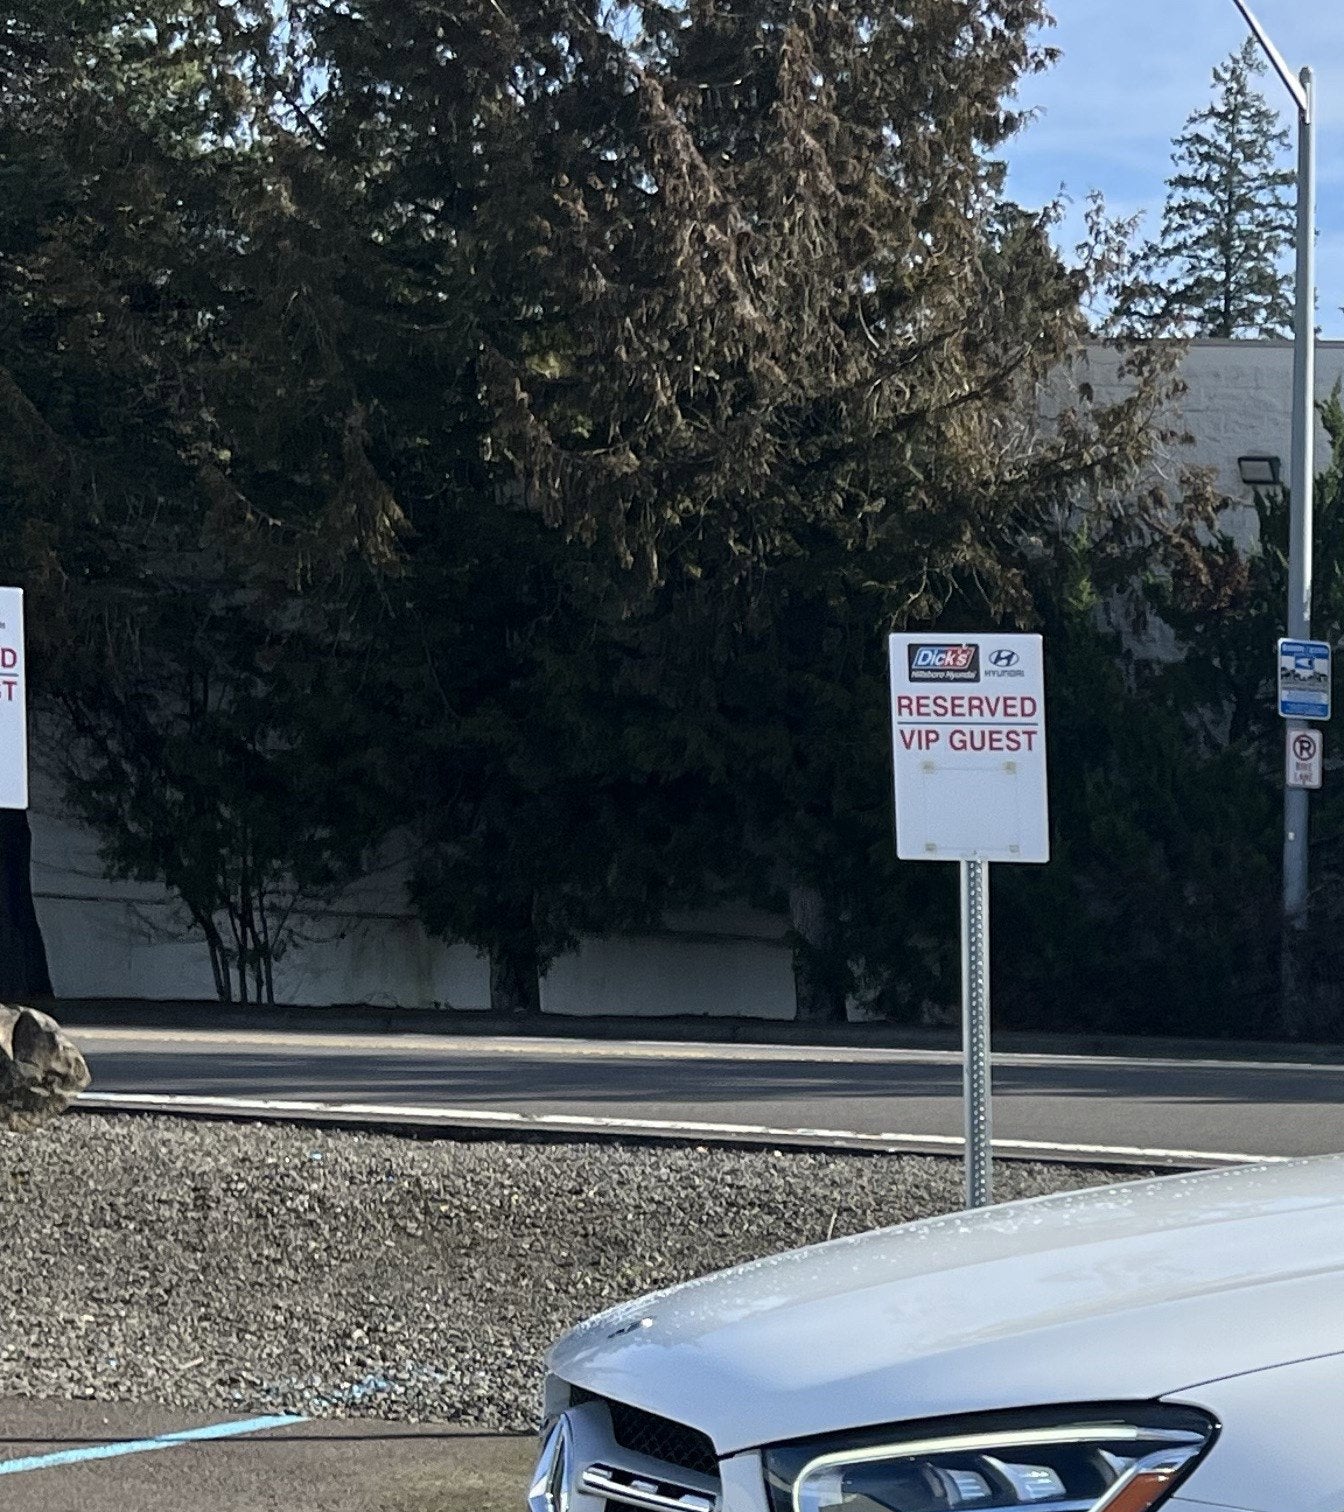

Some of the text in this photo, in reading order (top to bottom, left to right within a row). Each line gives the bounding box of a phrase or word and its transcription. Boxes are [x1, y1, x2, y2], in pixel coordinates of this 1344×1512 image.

[984, 669, 1025, 678] HYUNDAI
[897, 695, 1037, 718] RESERVED
[899, 728, 1038, 752] VIP GUEST
